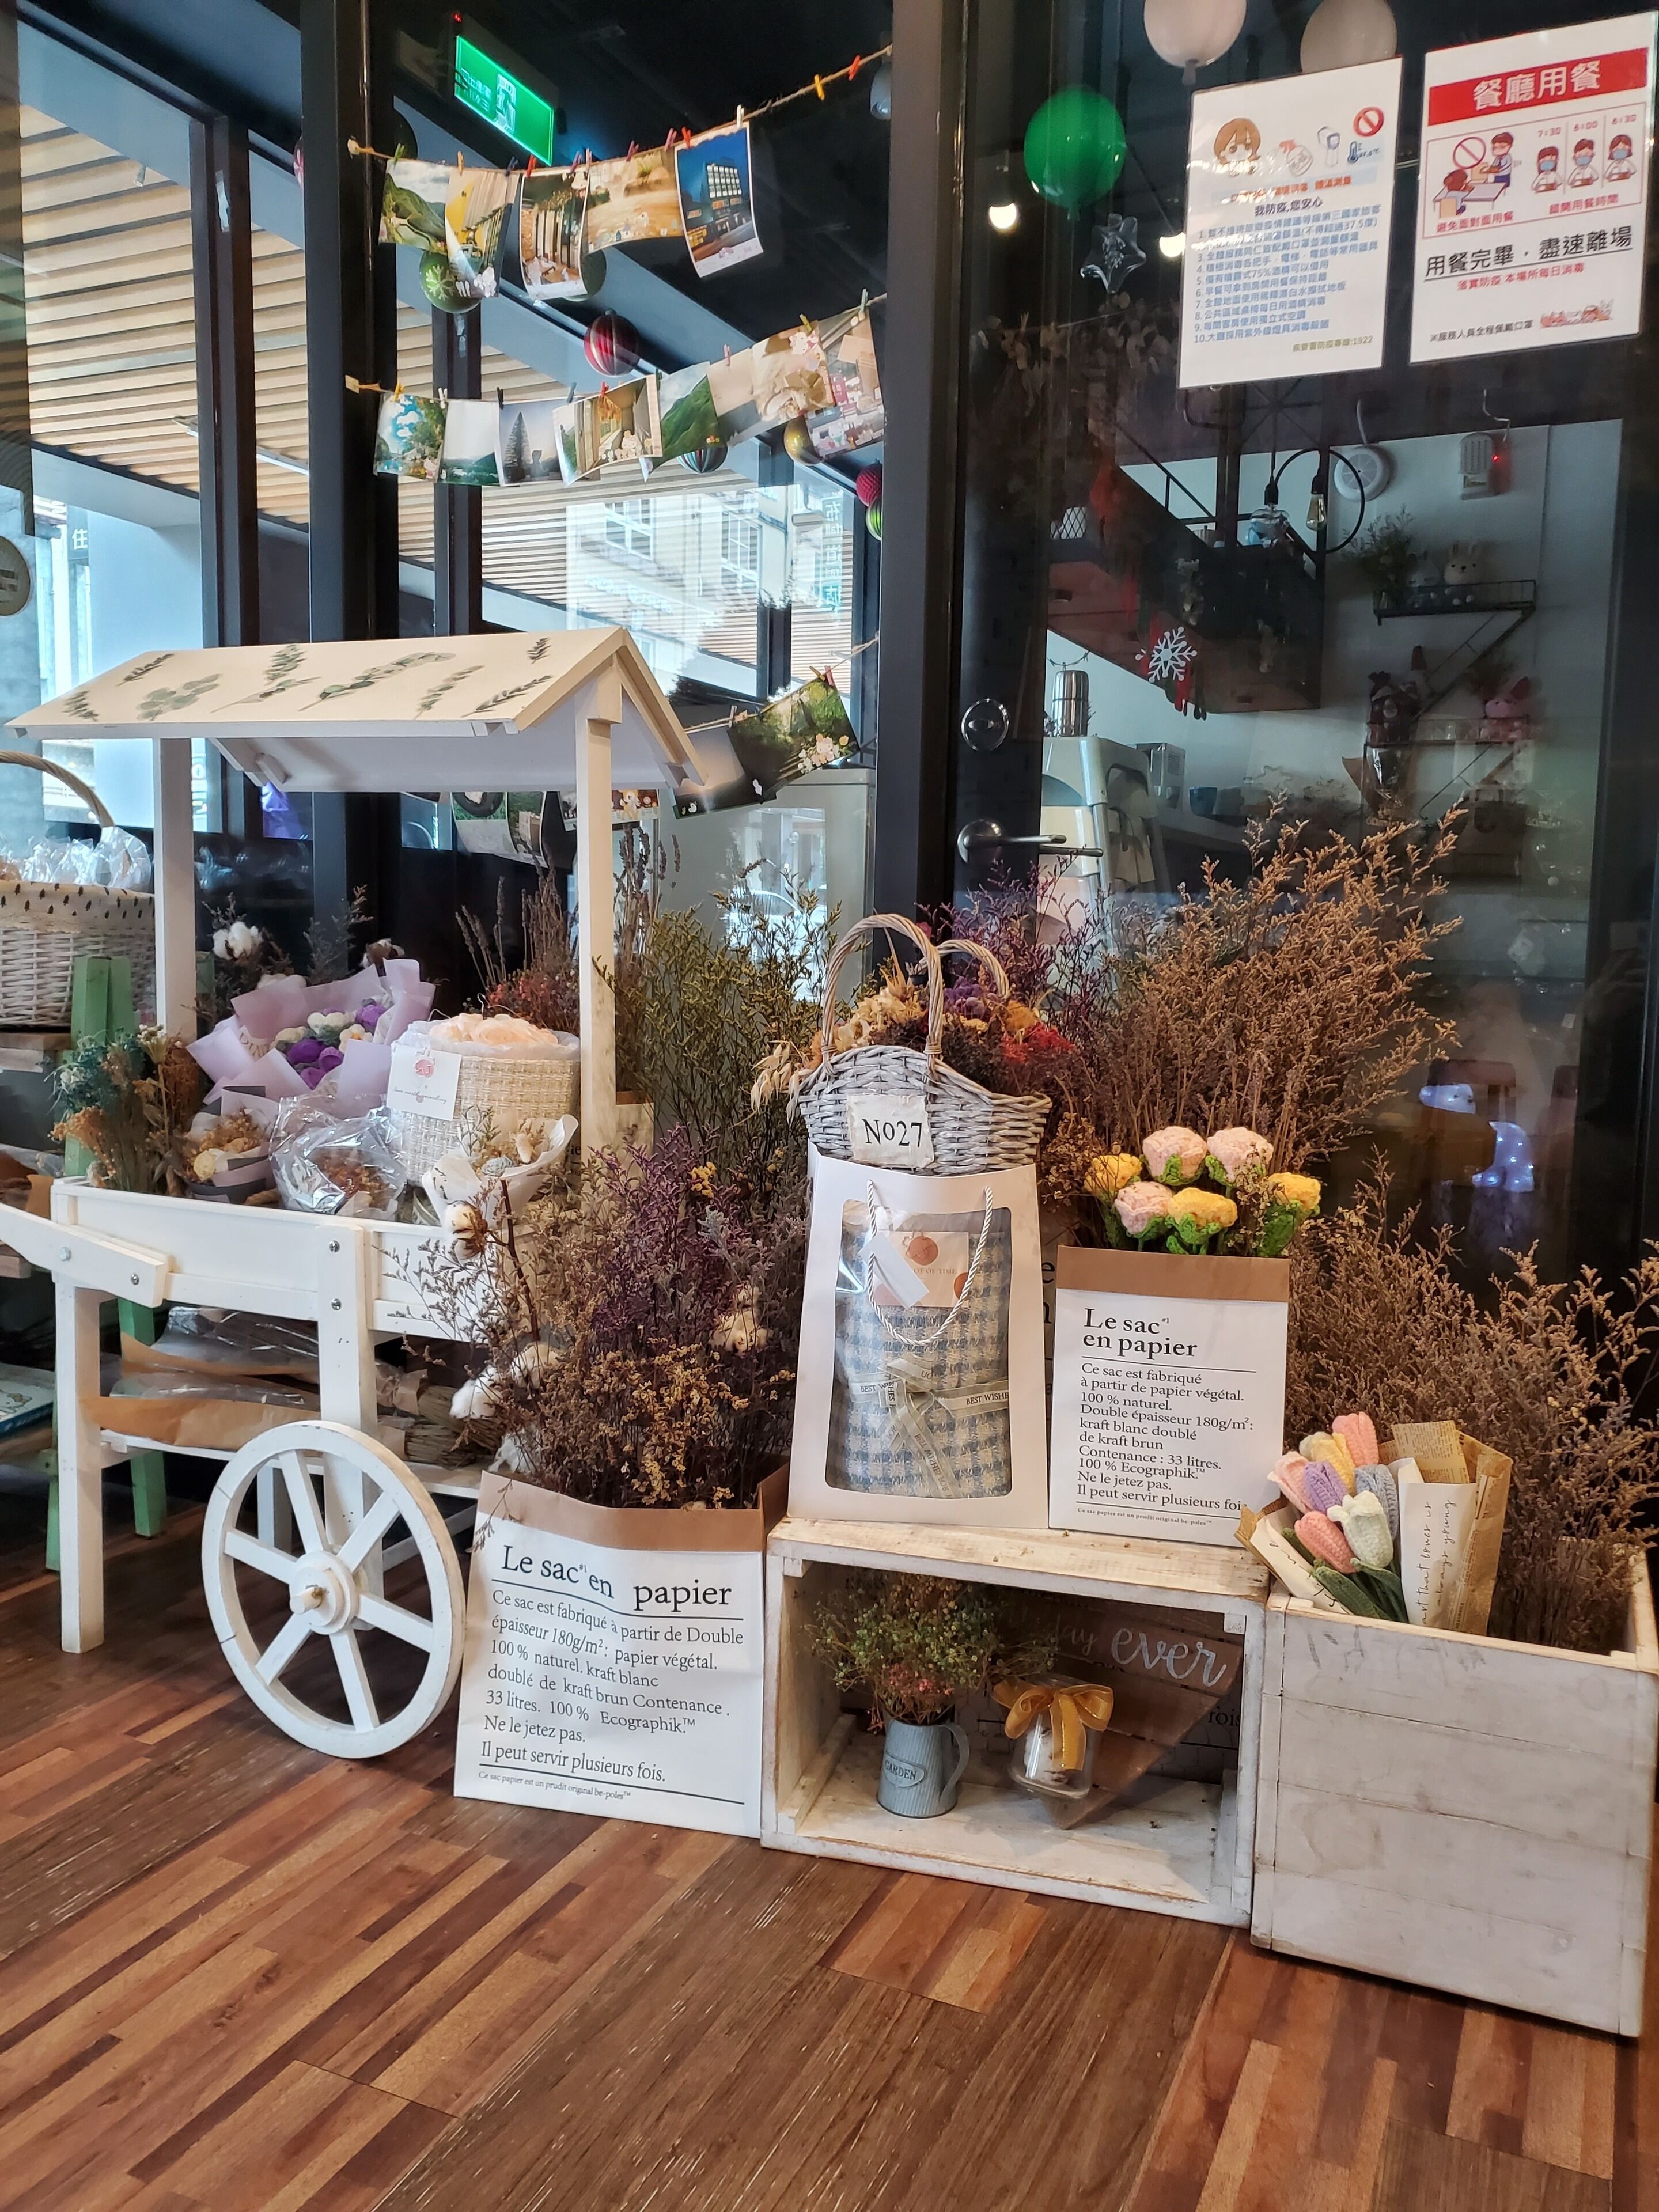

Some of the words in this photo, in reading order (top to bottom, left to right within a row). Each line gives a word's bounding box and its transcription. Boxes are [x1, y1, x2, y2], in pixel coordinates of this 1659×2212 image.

[1472, 59, 1601, 112] 餐廳用餐
[1548, 192, 1619, 215] 錯開用餐時間
[1437, 210, 1514, 233] 避免面對面用餐
[1084, 1308, 1116, 1329] Le
[1084, 1335, 1112, 1349] en
[1117, 1338, 1198, 1360] papier
[1082, 1363, 1099, 1374] Ce
[1103, 1368, 1122, 1377] sac
[1126, 1370, 1143, 1379] est
[1147, 1369, 1202, 1386] fabriqué
[966, 1396, 982, 1405] BEST
[1081, 1377, 1088, 1387] à
[1092, 1381, 1128, 1391] partir
[1131, 1382, 1146, 1393] de
[1150, 1386, 1192, 1398] papier
[1195, 1389, 1244, 1402] végétal.
[1082, 1392, 1103, 1403] 100
[1123, 1399, 1172, 1411] naturel.
[1081, 1404, 1128, 1418] Double
[1132, 1410, 1192, 1425] épaisseur
[1080, 1417, 1109, 1430] kraft
[1113, 1421, 1148, 1434] blanc
[1152, 1426, 1196, 1440] doublé
[1080, 1431, 1094, 1442] de
[1098, 1433, 1128, 1446] kraft
[1132, 1437, 1163, 1449] brun
[1079, 1445, 1157, 1463] Contenance
[1168, 1455, 1183, 1465] 33
[1187, 1456, 1221, 1472] litres.
[1080, 1458, 1101, 1469] 100
[1078, 1471, 1096, 1482] Ne
[1100, 1473, 1111, 1483] le
[1113, 1475, 1143, 1487] jetez
[1147, 1481, 1171, 1491] pas.
[1078, 1484, 1086, 1495] Il
[1090, 1488, 1118, 1499] peut
[1122, 1492, 1158, 1502] servir
[1162, 1494, 1220, 1509] plusieurs
[1443, 1499, 1457, 1544] young
[502, 1545, 533, 1573] Le
[589, 1575, 614, 1599] en
[633, 1579, 732, 1612] papier
[1415, 1563, 1430, 1595] that
[493, 1590, 511, 1605] Ce
[514, 1598, 534, 1610] sac
[537, 1603, 554, 1615] est
[558, 1602, 607, 1631] fabriqué
[611, 1620, 618, 1634] à
[621, 1626, 660, 1642] partir
[664, 1626, 682, 1641] de
[687, 1627, 743, 1644] Double
[491, 1614, 549, 1639] épaisseur
[615, 1649, 659, 1668] papier
[662, 1653, 717, 1672] végétal.
[491, 1639, 514, 1656] 100
[535, 1654, 582, 1673] naturel.
[586, 1661, 616, 1682] kraft
[619, 1669, 658, 1687] blanc
[1111, 1627, 1227, 1687] ever
[488, 1663, 533, 1687] doublé
[540, 1675, 556, 1690] de
[563, 1677, 593, 1699] kraft
[596, 1687, 628, 1706] brun
[486, 1690, 502, 1705] 33
[507, 1691, 541, 1713] litres.
[551, 1701, 573, 1716] 100
[484, 1715, 506, 1731] Ne
[509, 1717, 521, 1733] le
[523, 1720, 556, 1739] jetez
[559, 1729, 585, 1744] pas.
[482, 1741, 491, 1756] Il
[494, 1747, 527, 1763] peut
[530, 1750, 569, 1766] servir
[571, 1753, 633, 1777] plusieurs
[637, 1762, 665, 1782] fois.
[884, 1760, 917, 1781] GARDEN
[502, 1774, 522, 1788] papier
[524, 1777, 534, 1787] est
[568, 1786, 593, 1795] original
